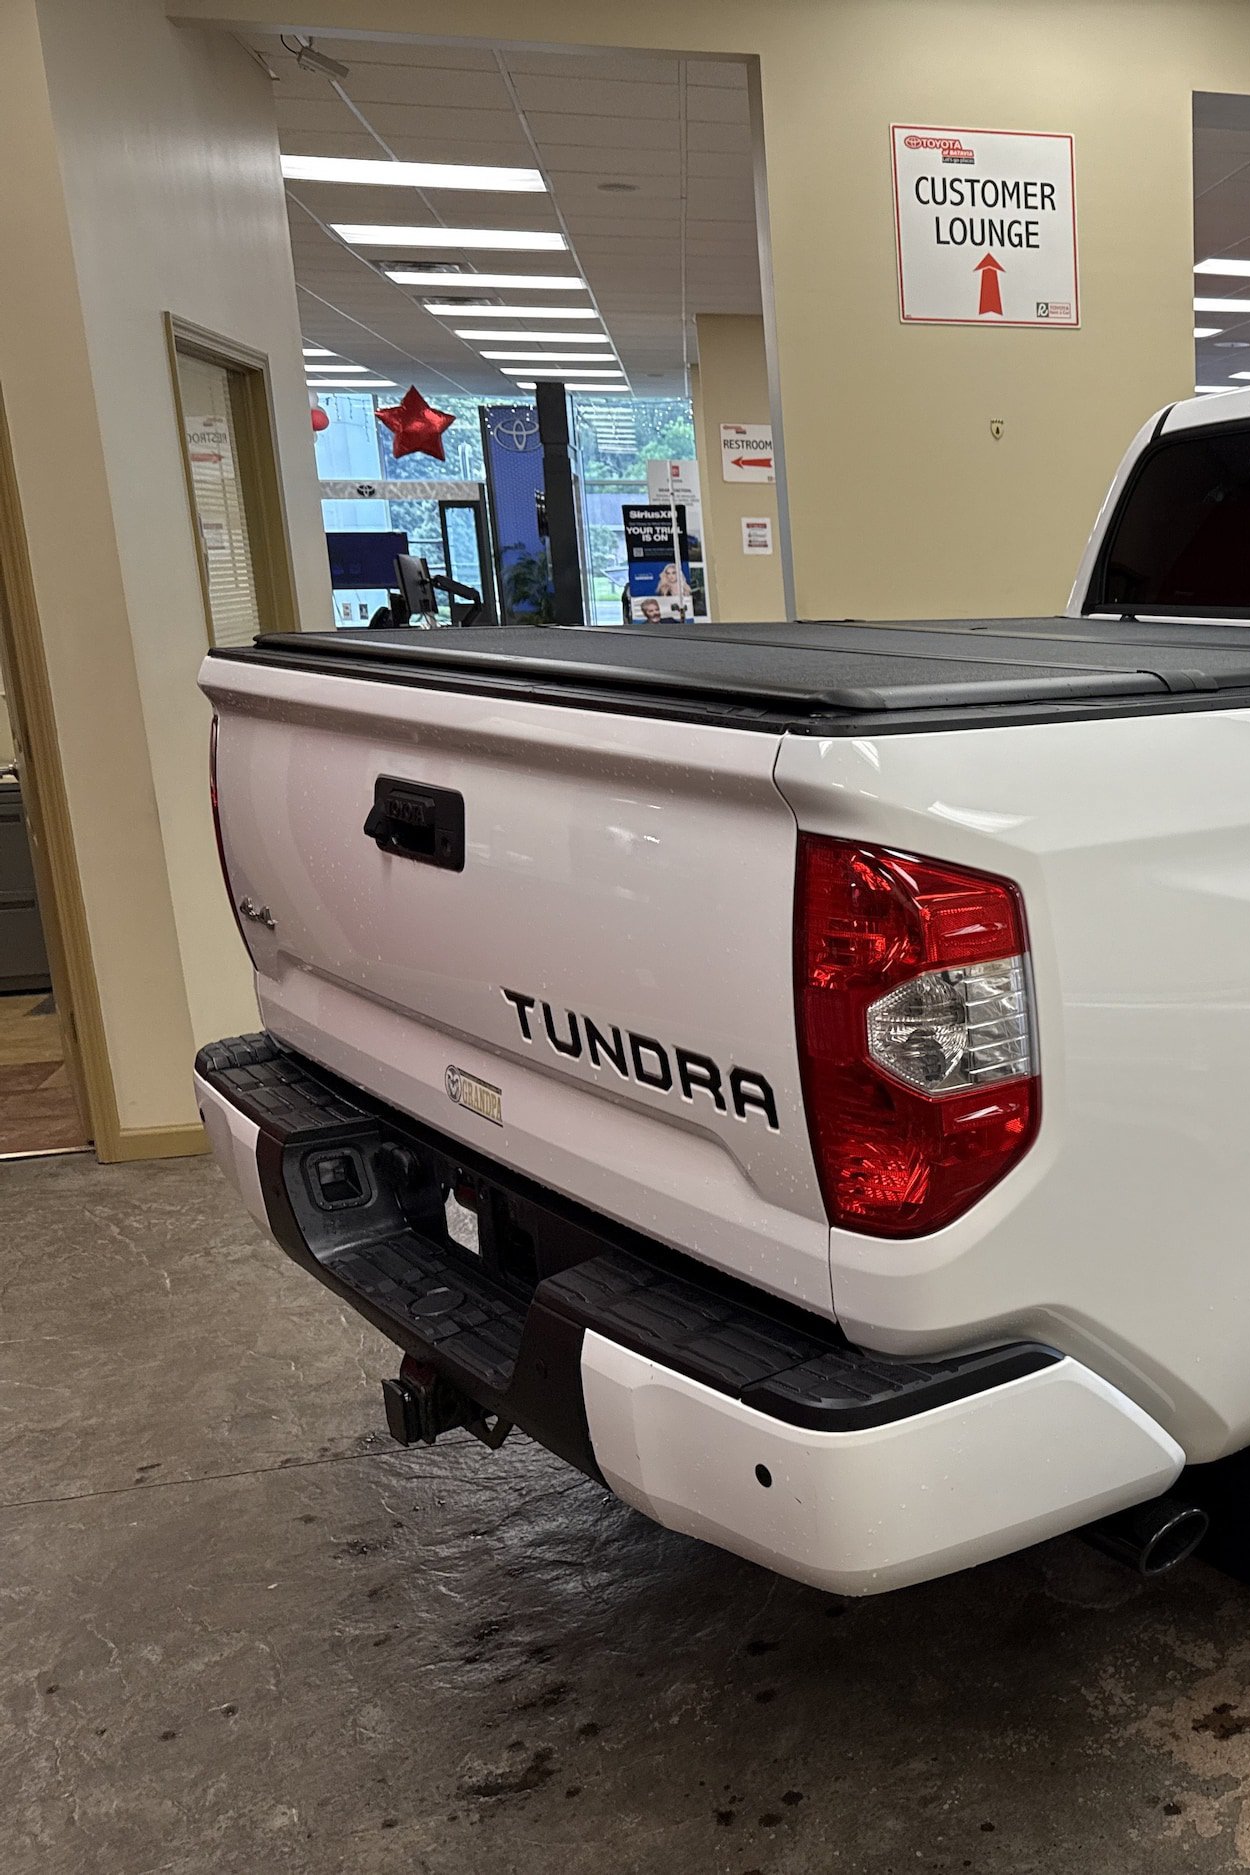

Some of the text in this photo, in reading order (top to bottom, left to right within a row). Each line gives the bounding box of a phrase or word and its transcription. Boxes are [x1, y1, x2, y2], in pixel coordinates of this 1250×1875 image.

[921, 139, 961, 149] TOYOTA
[915, 176, 1056, 211] CUSTOMER
[935, 216, 1040, 249] LOUNGE
[723, 439, 773, 450] RESTROOM
[626, 526, 654, 535] YOUR
[642, 534, 669, 542] IS ON
[499, 985, 780, 1134] TUNDRA
[462, 1078, 503, 1122] GRANDPA
